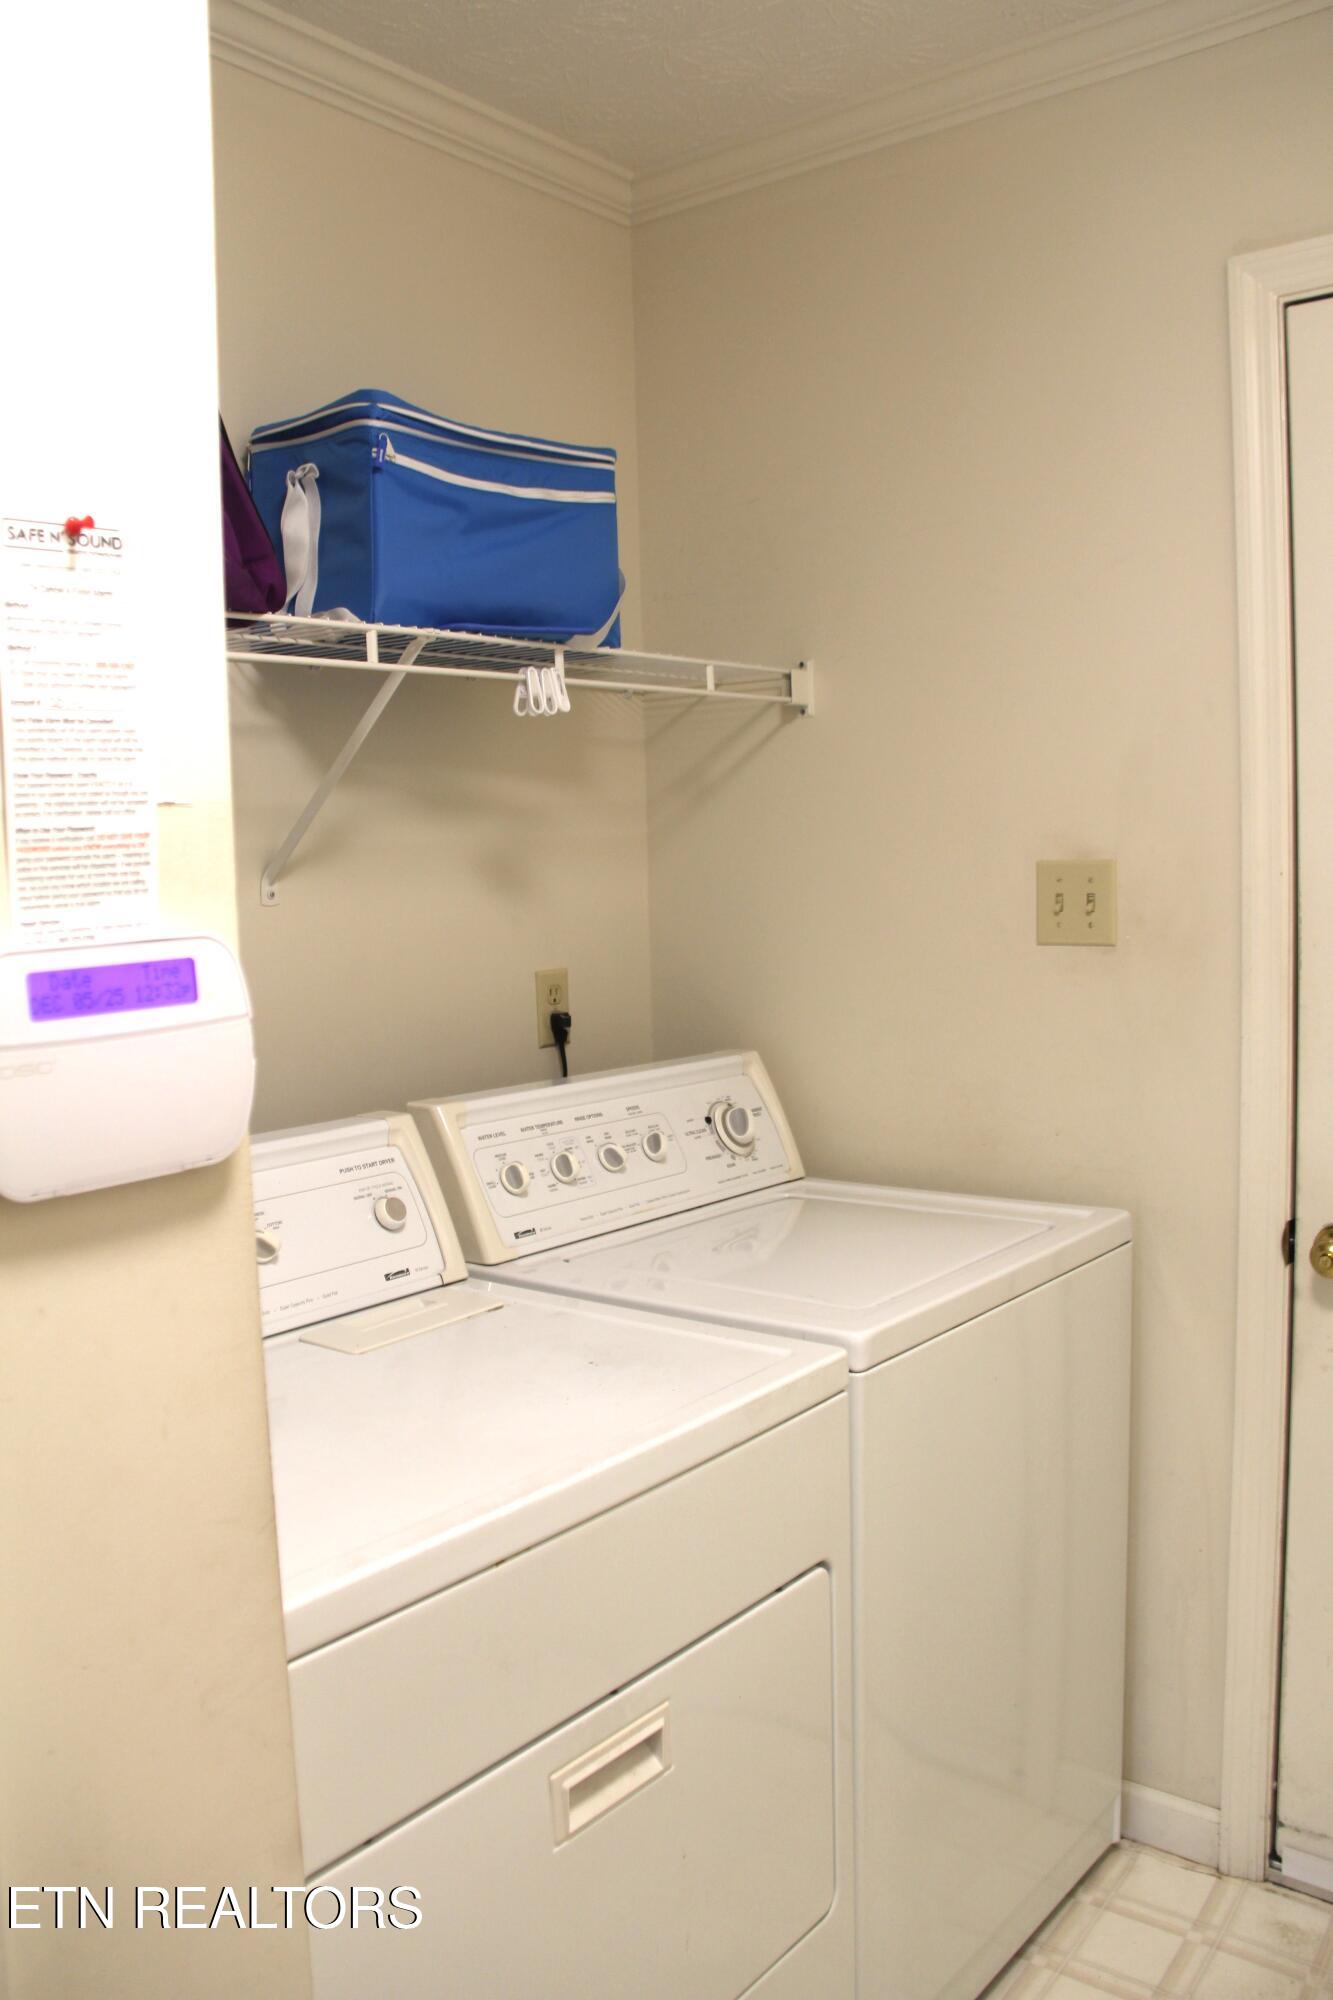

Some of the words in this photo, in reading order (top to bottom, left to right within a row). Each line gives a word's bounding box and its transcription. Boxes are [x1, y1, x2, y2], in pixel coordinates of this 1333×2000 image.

[7, 526, 45, 543] SAFE
[67, 532, 122, 550] SOUND
[49, 971, 92, 992] Date
[142, 962, 180, 981] Time
[339, 1166, 354, 1174] PUSH
[363, 1161, 378, 1170] START
[379, 1157, 395, 1166] DRYER
